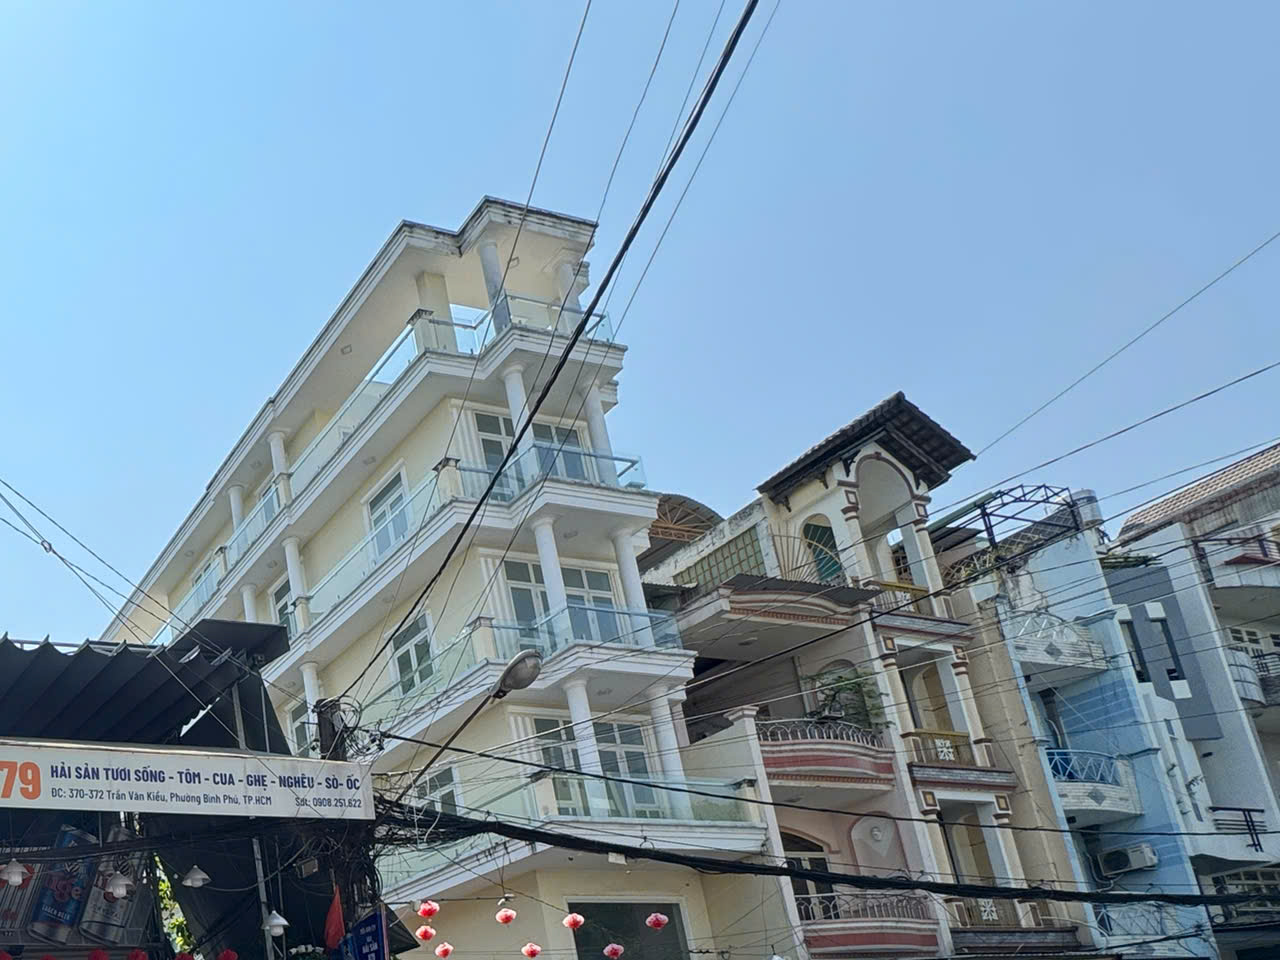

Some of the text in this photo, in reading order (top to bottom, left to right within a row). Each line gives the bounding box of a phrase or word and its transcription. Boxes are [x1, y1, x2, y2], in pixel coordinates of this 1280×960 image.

[50, 762, 71, 779] HẢI
[75, 763, 100, 780] SẢN
[103, 767, 131, 781] TƯƠI
[134, 765, 166, 783] SỐNG
[177, 768, 201, 784] TÔM
[212, 772, 235, 786] CUA
[246, 773, 268, 791] GHẸ
[279, 773, 314, 789] NGHÊU
[347, 774, 360, 790] ỐC
[51, 788, 66, 798] ĐC:
[68, 788, 104, 800] 370-372
[128, 790, 145, 801] Văn
[170, 791, 201, 806] Phường
[203, 793, 220, 804] Bình
[243, 795, 272, 806] TP.HCM
